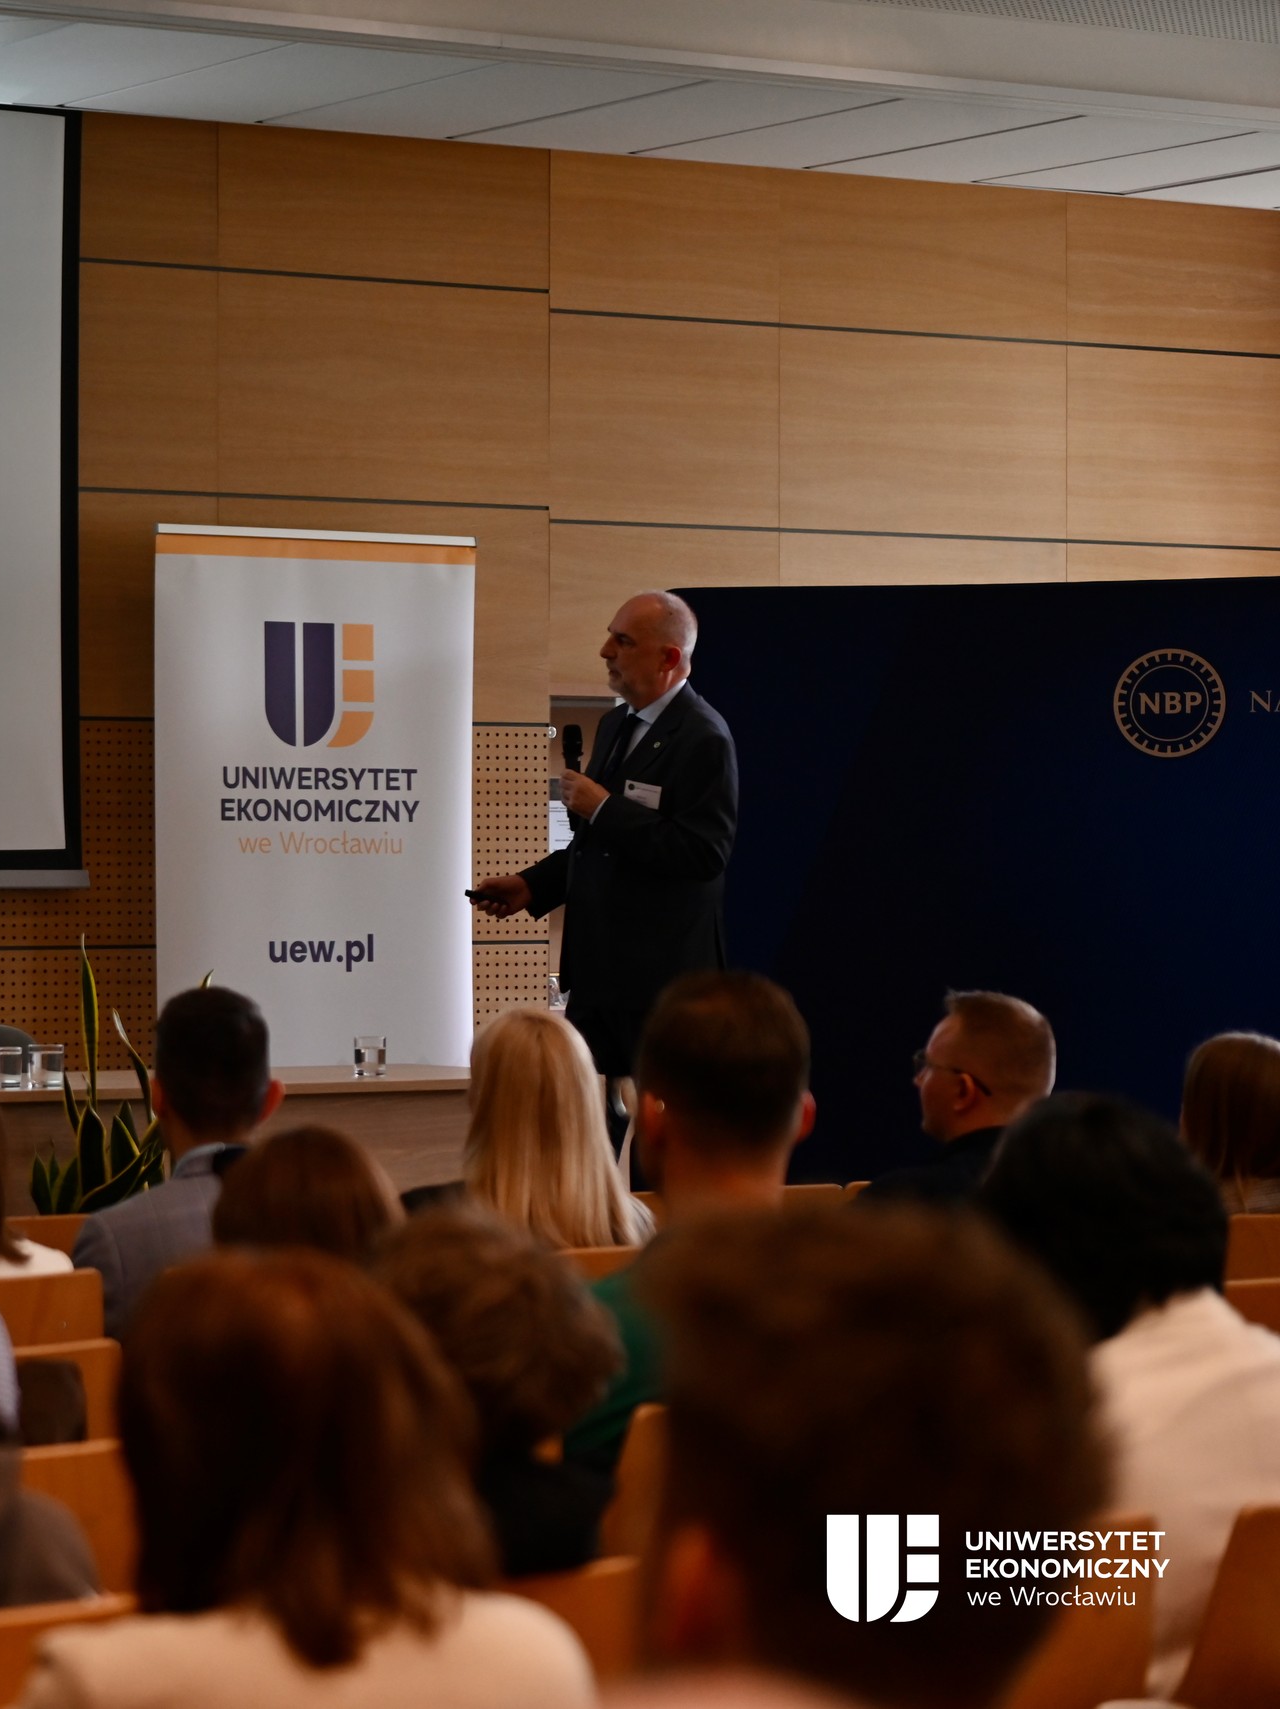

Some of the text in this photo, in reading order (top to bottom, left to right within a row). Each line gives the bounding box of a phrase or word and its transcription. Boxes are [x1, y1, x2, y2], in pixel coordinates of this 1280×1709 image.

[1139, 692, 1202, 715] NBP
[222, 766, 418, 791] UNIWERSYTET
[220, 798, 420, 823] EKONOMICZNY
[238, 832, 403, 855] we Wrocławiu
[269, 934, 374, 971] uew.pl
